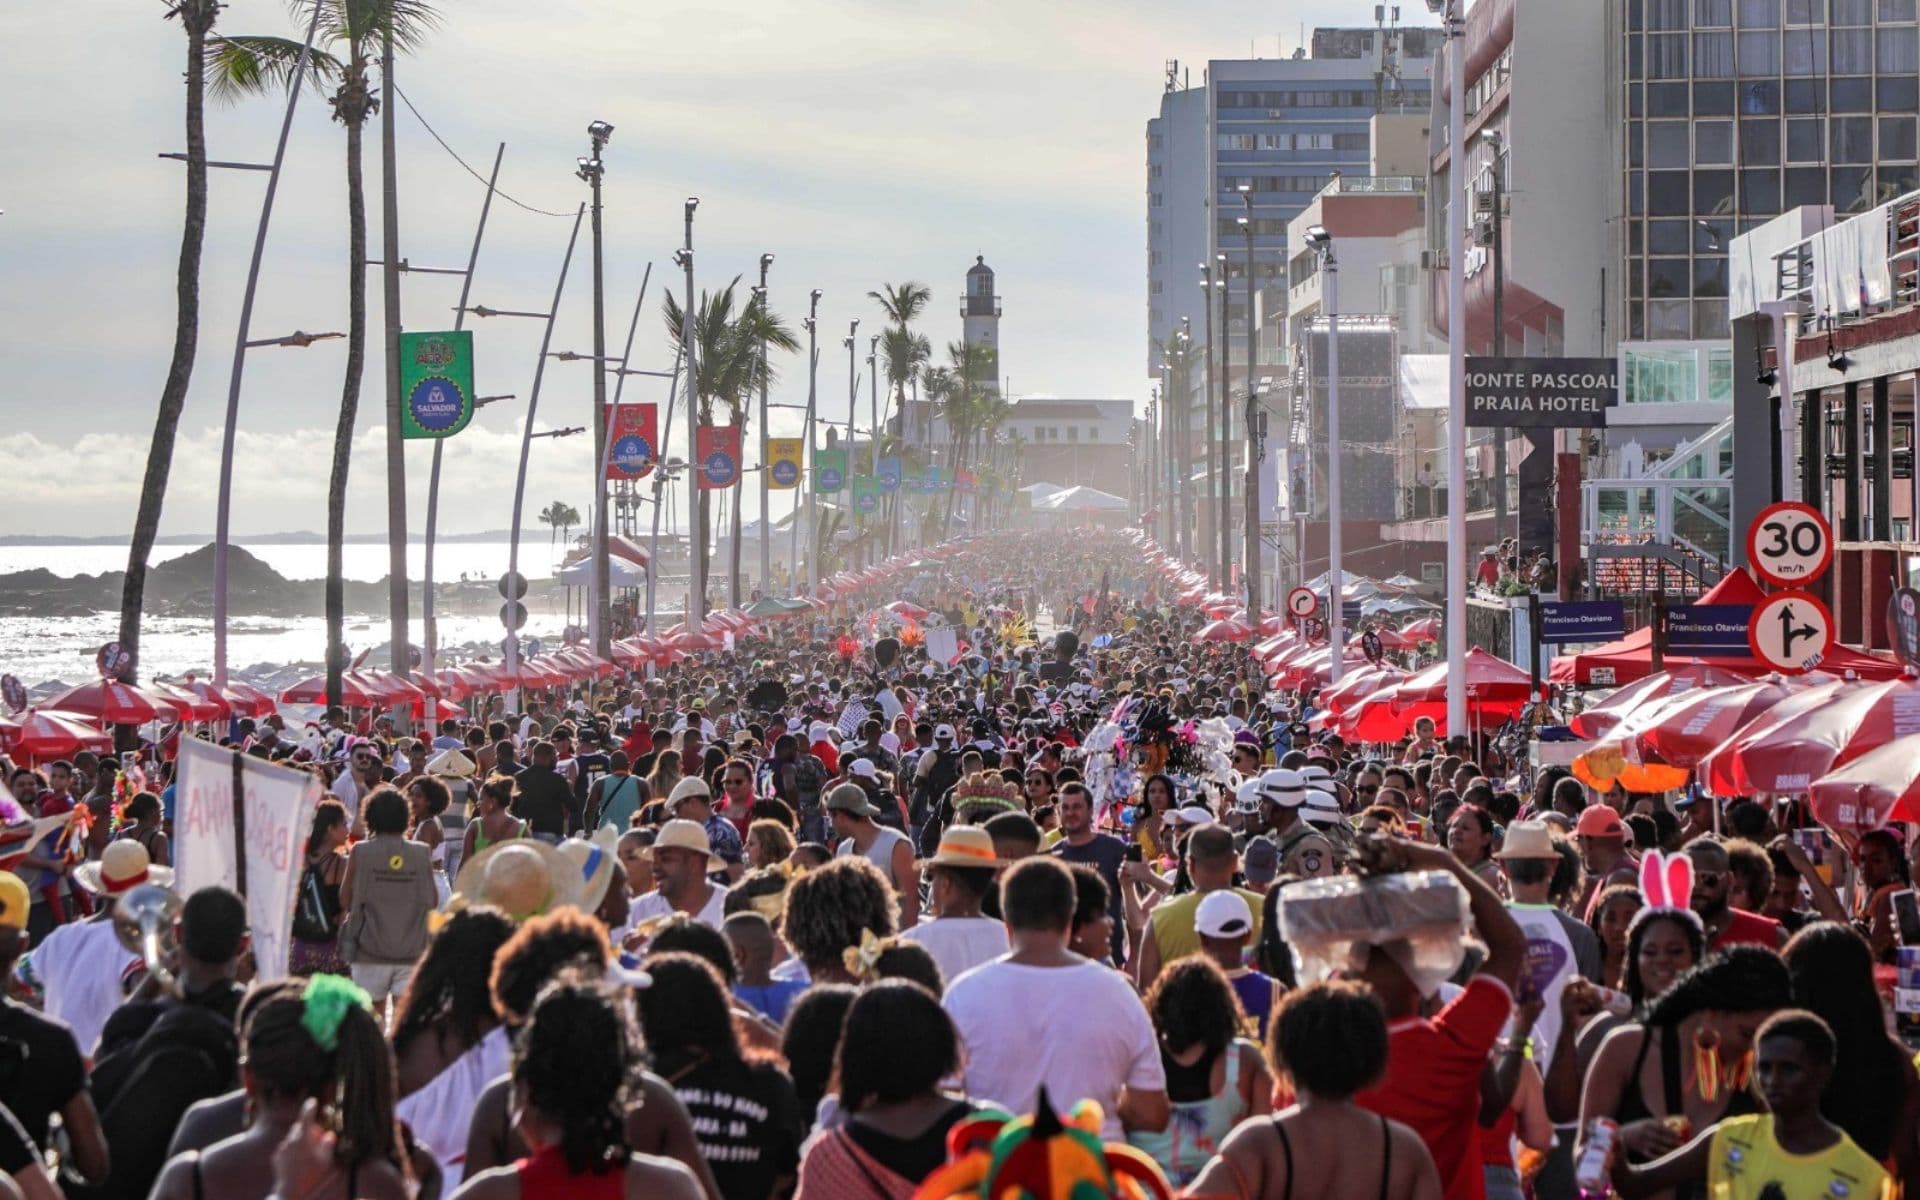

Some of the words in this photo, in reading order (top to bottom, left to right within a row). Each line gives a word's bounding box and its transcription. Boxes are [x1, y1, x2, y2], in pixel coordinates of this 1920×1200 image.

[1531, 373, 1618, 389] PASCOAL
[416, 404, 456, 412] SALVADOR
[1474, 396, 1533, 411] PRAIA
[1539, 397, 1600, 412] HOTEL
[1762, 522, 1821, 557] 30
[1778, 565, 1805, 573] km/h
[1543, 615, 1580, 624] Francisco
[1580, 614, 1613, 623] Otaviano
[1669, 612, 1687, 620] Rua
[1669, 623, 1714, 632] Francisco
[1714, 623, 1749, 632] Otavian
